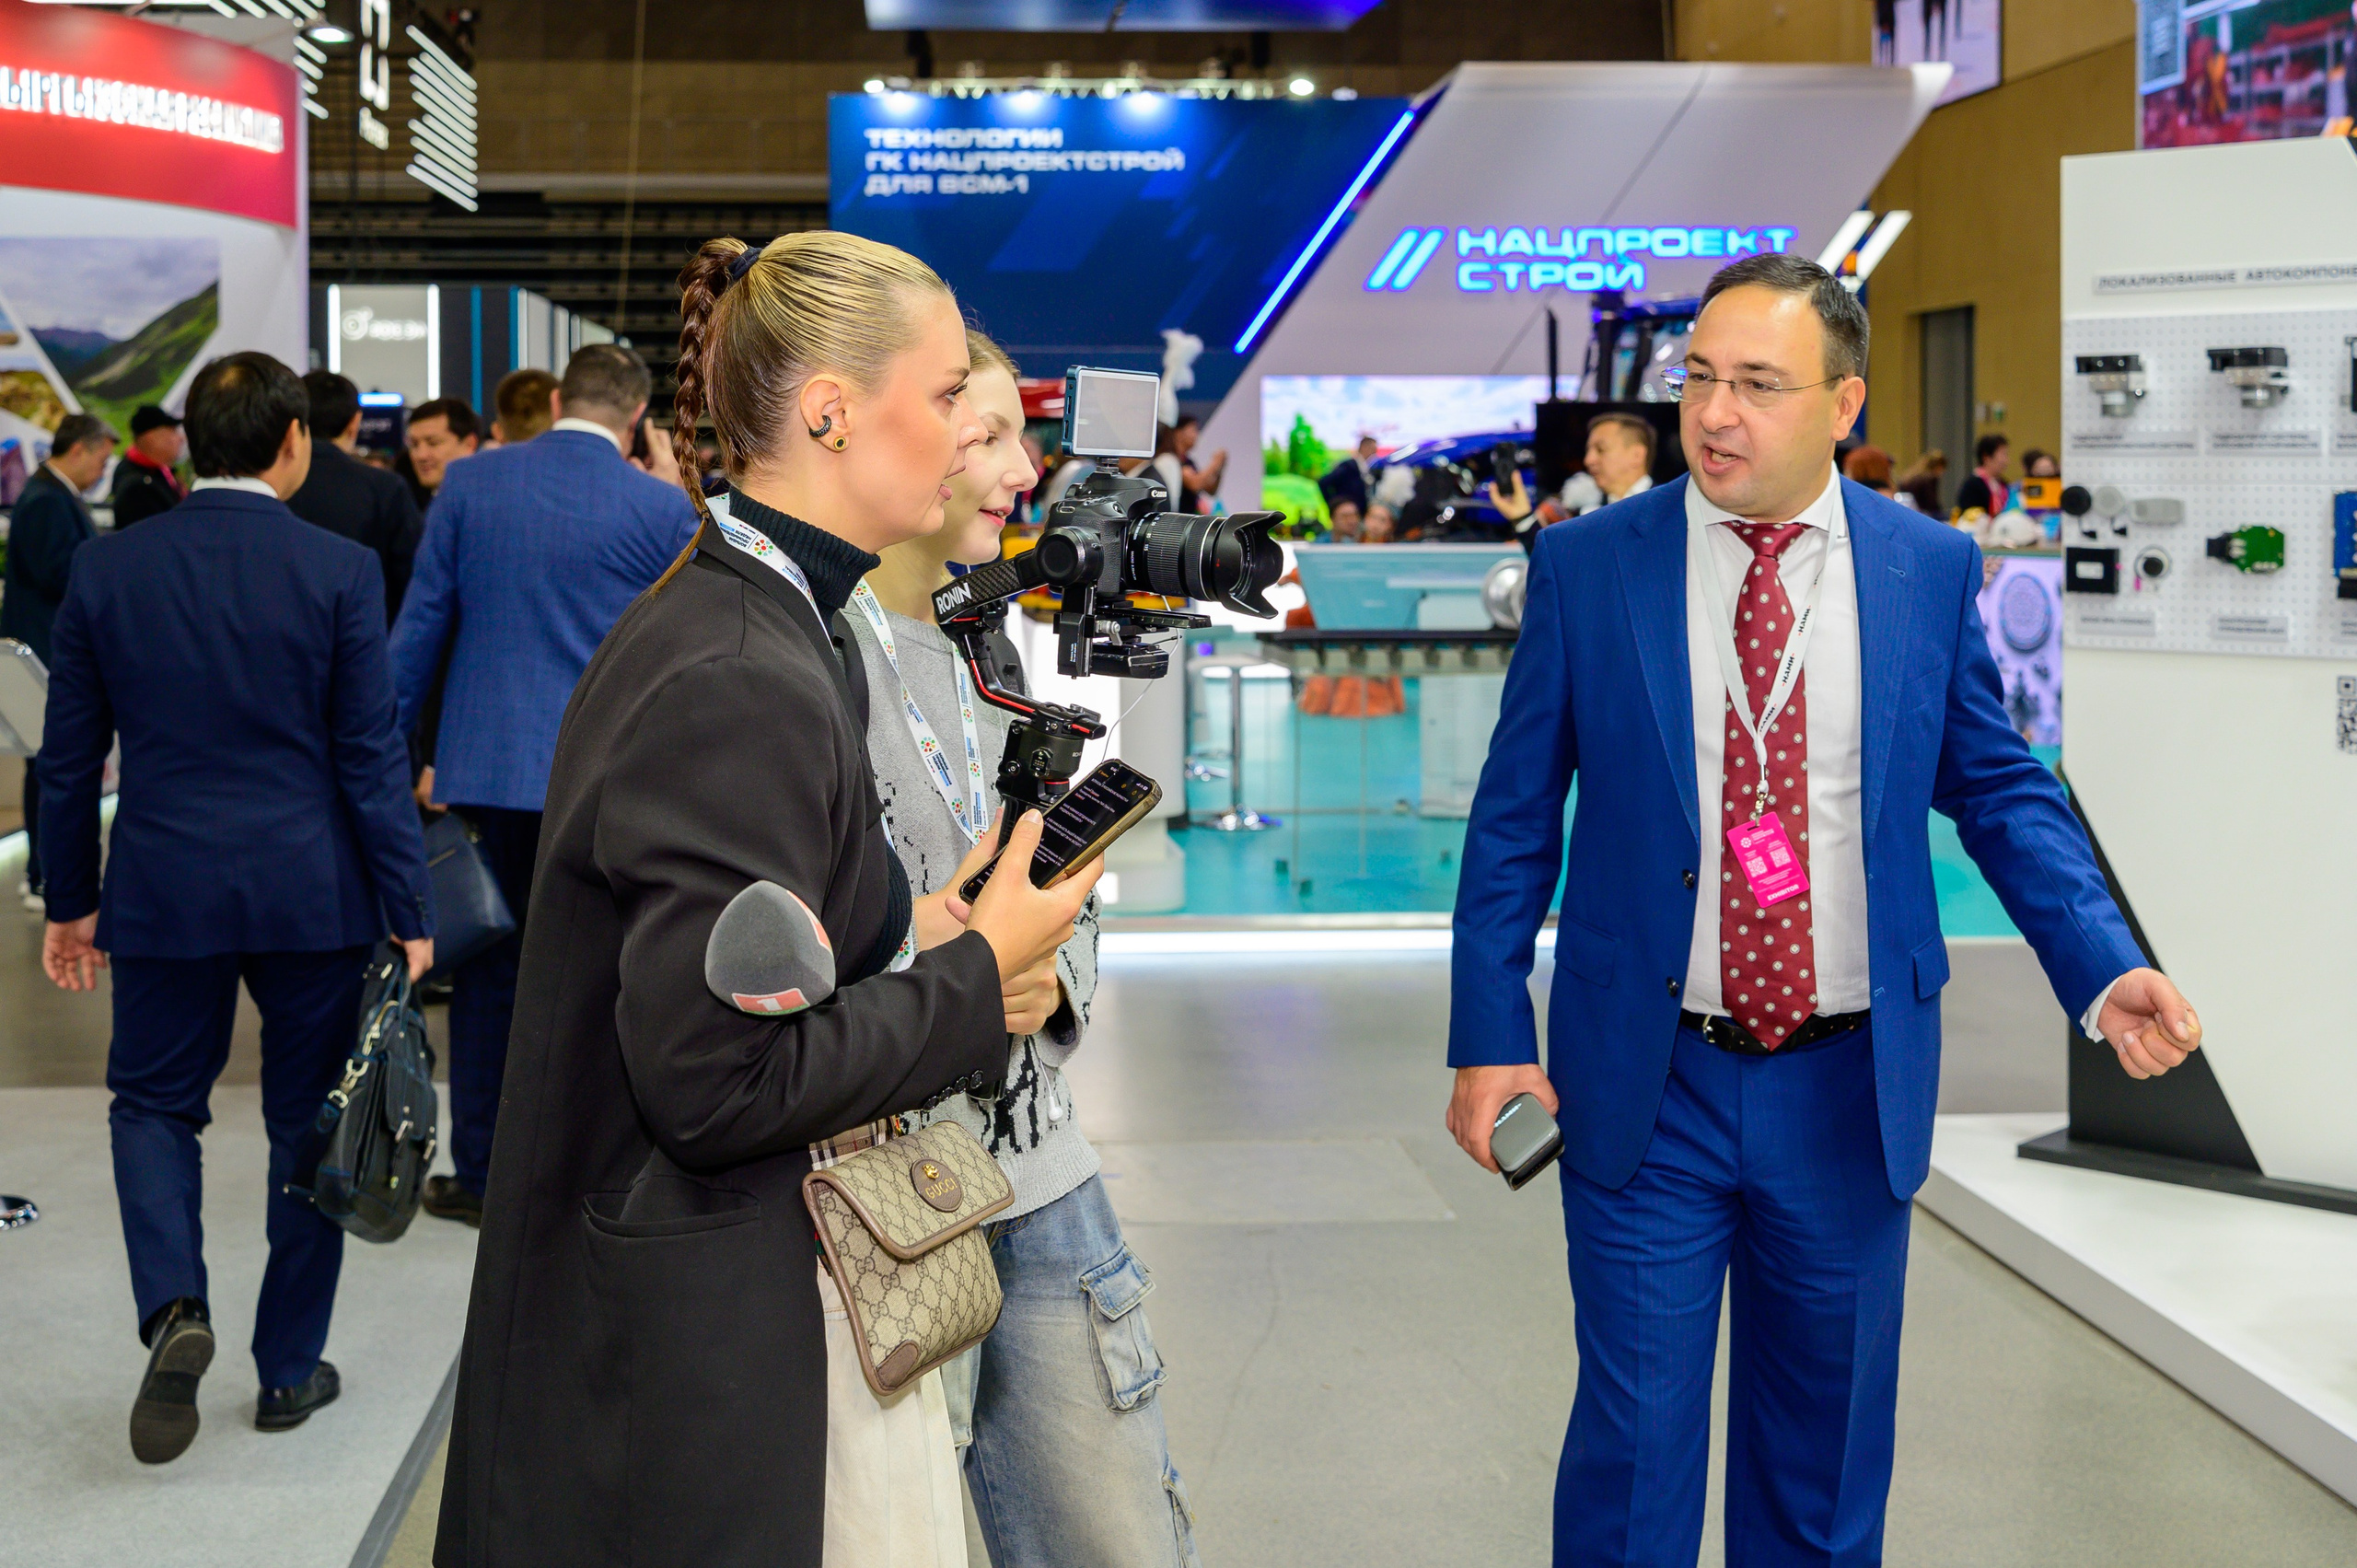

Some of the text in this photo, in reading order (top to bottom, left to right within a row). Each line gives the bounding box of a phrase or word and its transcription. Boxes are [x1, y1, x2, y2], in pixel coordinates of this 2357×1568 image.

[864, 128, 1063, 148] ТЕХНОЛОГИИ
[864, 146, 1186, 173] ГК НАЦПРОЕКТСТРОЙ
[864, 173, 1029, 197] ДЛЯ ВСМ-1
[1457, 226, 1795, 260] НАЦПРОЕКТ
[1457, 257, 1646, 291] СТРОЙ
[2098, 271, 2237, 290] ЛОКАЛИЗОВАННЫЕ
[935, 582, 972, 615] RONIN
[1798, 608, 1811, 633] НАМИ
[1782, 656, 1795, 683] НАМИ
[1767, 884, 1800, 901] EXHIBITOR
[756, 997, 783, 1011] 1
[924, 1178, 958, 1200] GUCCI
